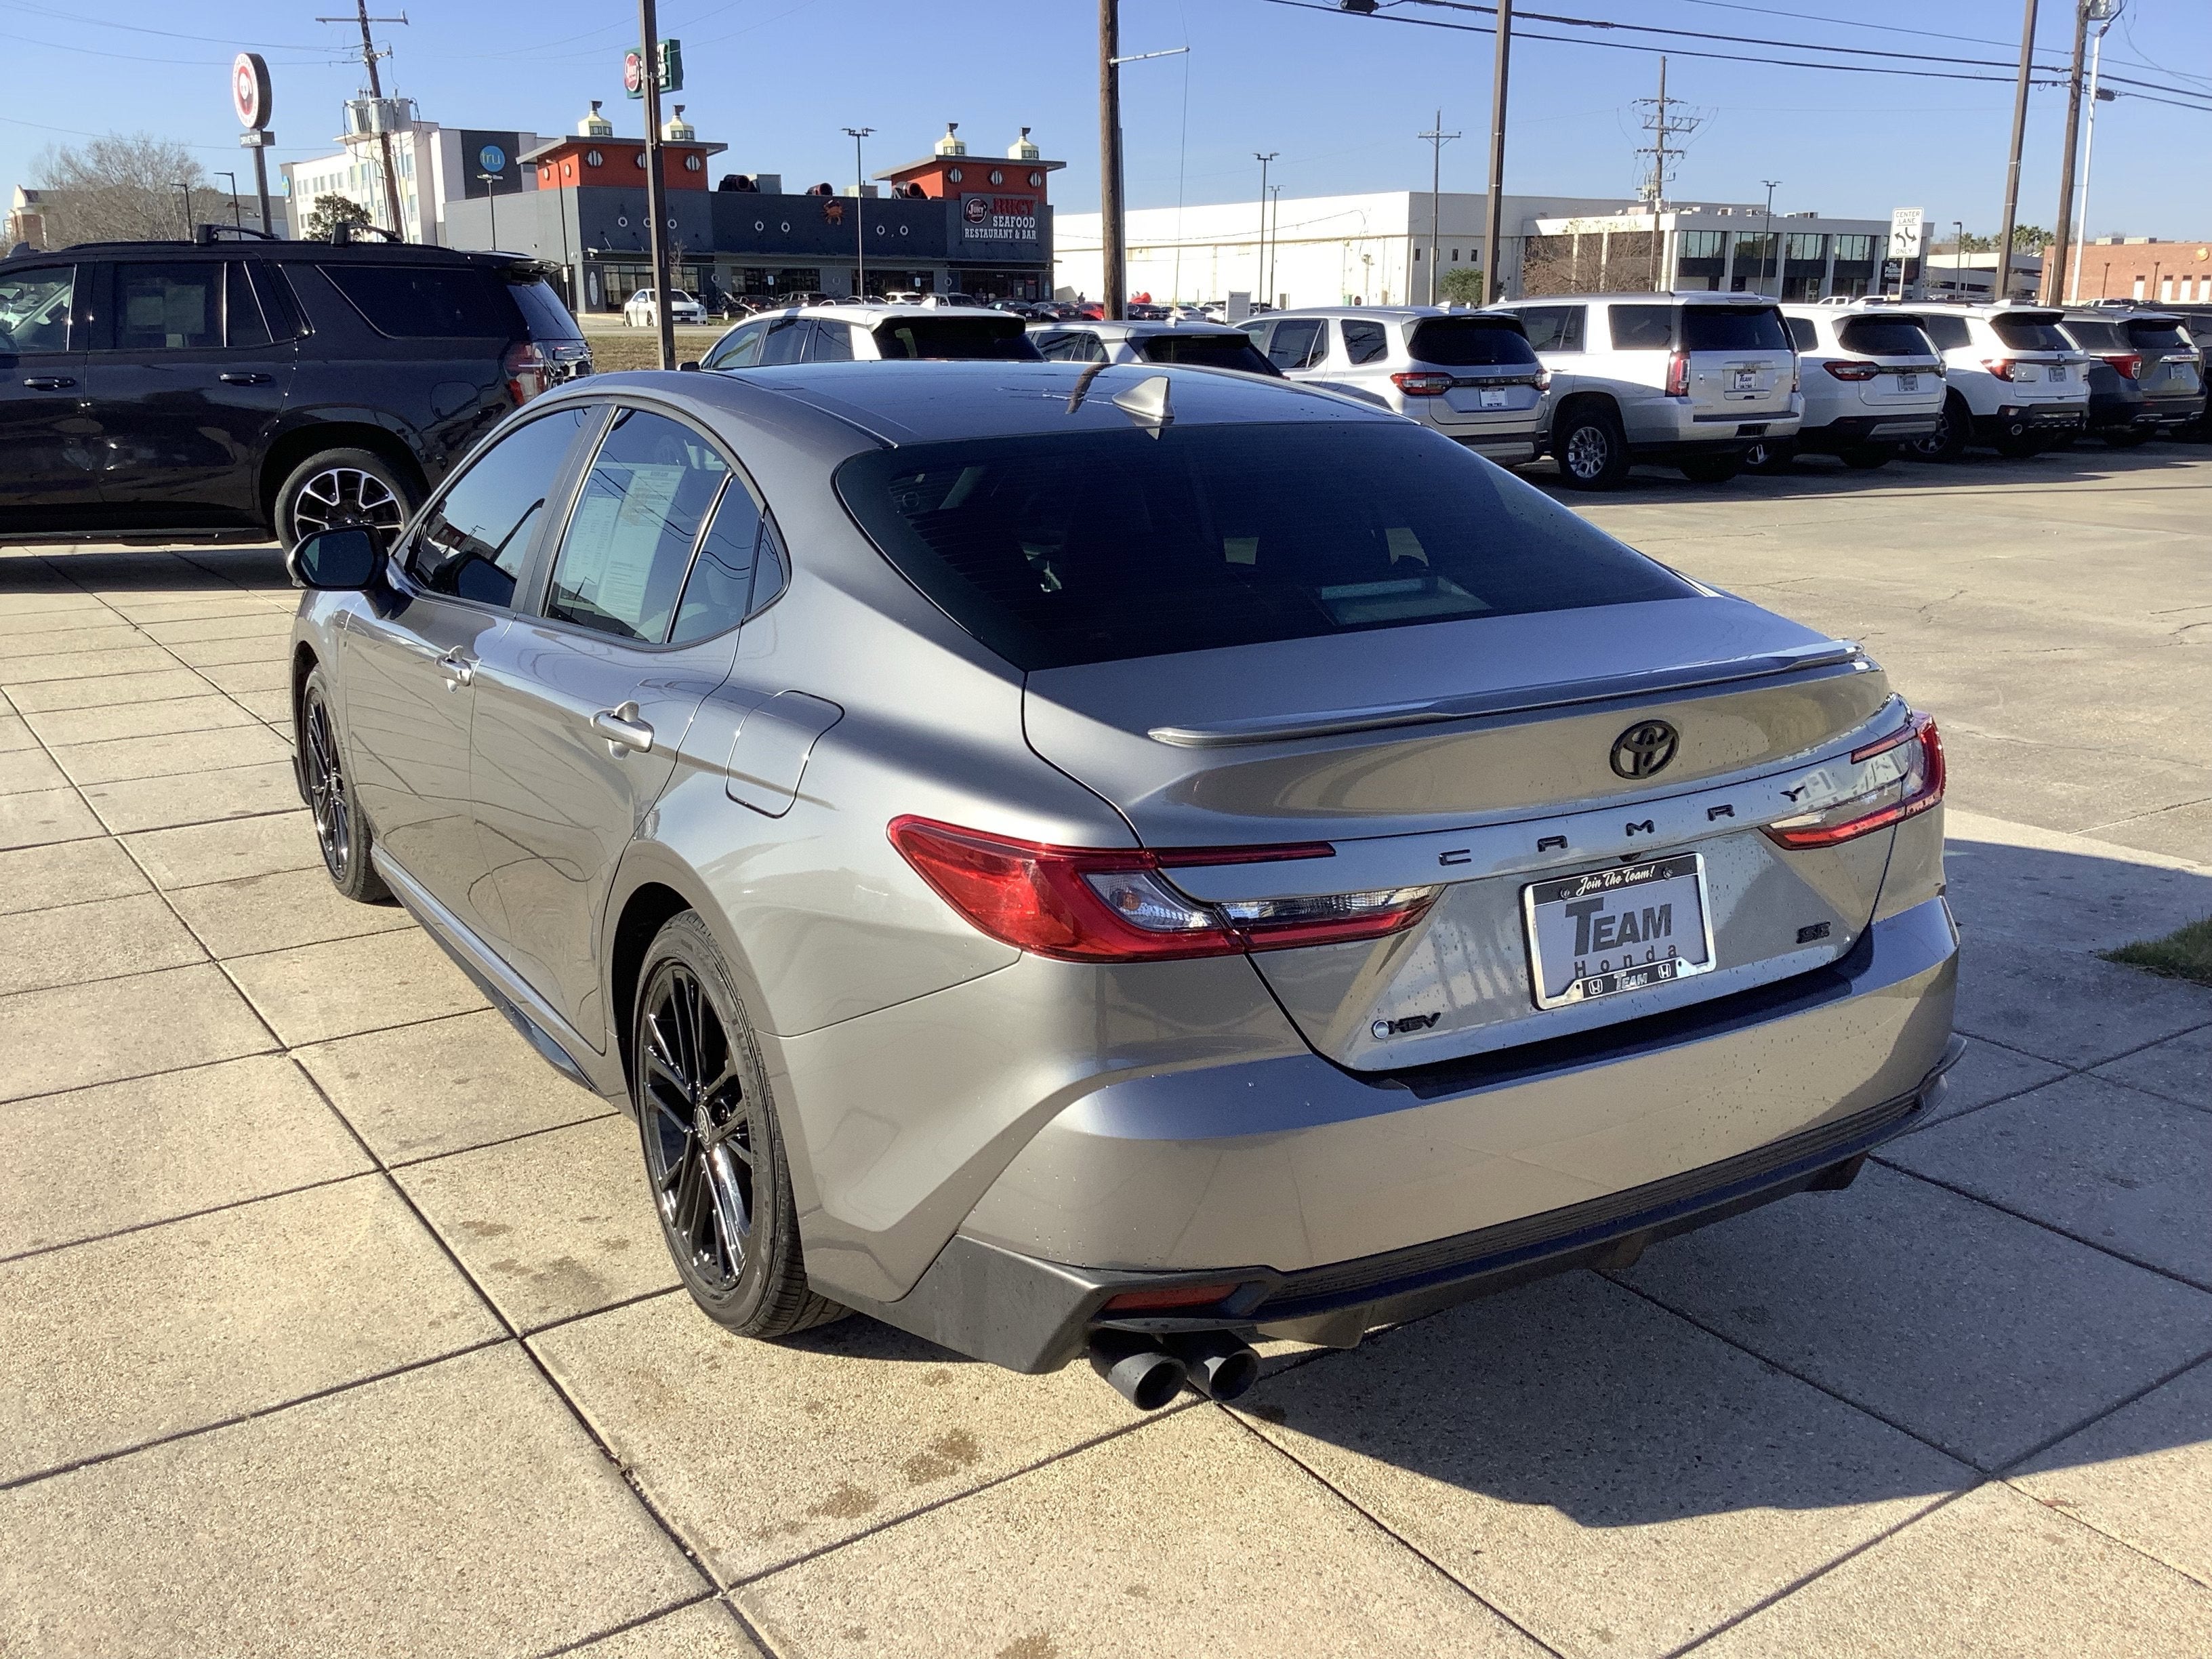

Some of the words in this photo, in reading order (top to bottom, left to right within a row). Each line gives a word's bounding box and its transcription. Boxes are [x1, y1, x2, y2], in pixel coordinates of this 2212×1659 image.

[481, 151, 500, 165] tru
[990, 198, 1033, 215] JUICY
[993, 216, 1036, 228] SEAFOOD
[965, 228, 1013, 239] RESTAURANT
[1015, 228, 1021, 239] &
[1022, 230, 1036, 240] BAR
[1438, 785, 1805, 867] CAMRY
[1576, 876, 1603, 897] Join
[1603, 871, 1623, 888] The
[1622, 865, 1656, 883] Team!
[1565, 897, 1673, 957] TEAM
[1574, 944, 1677, 979] Honda
[1614, 970, 1648, 991] TEAM
